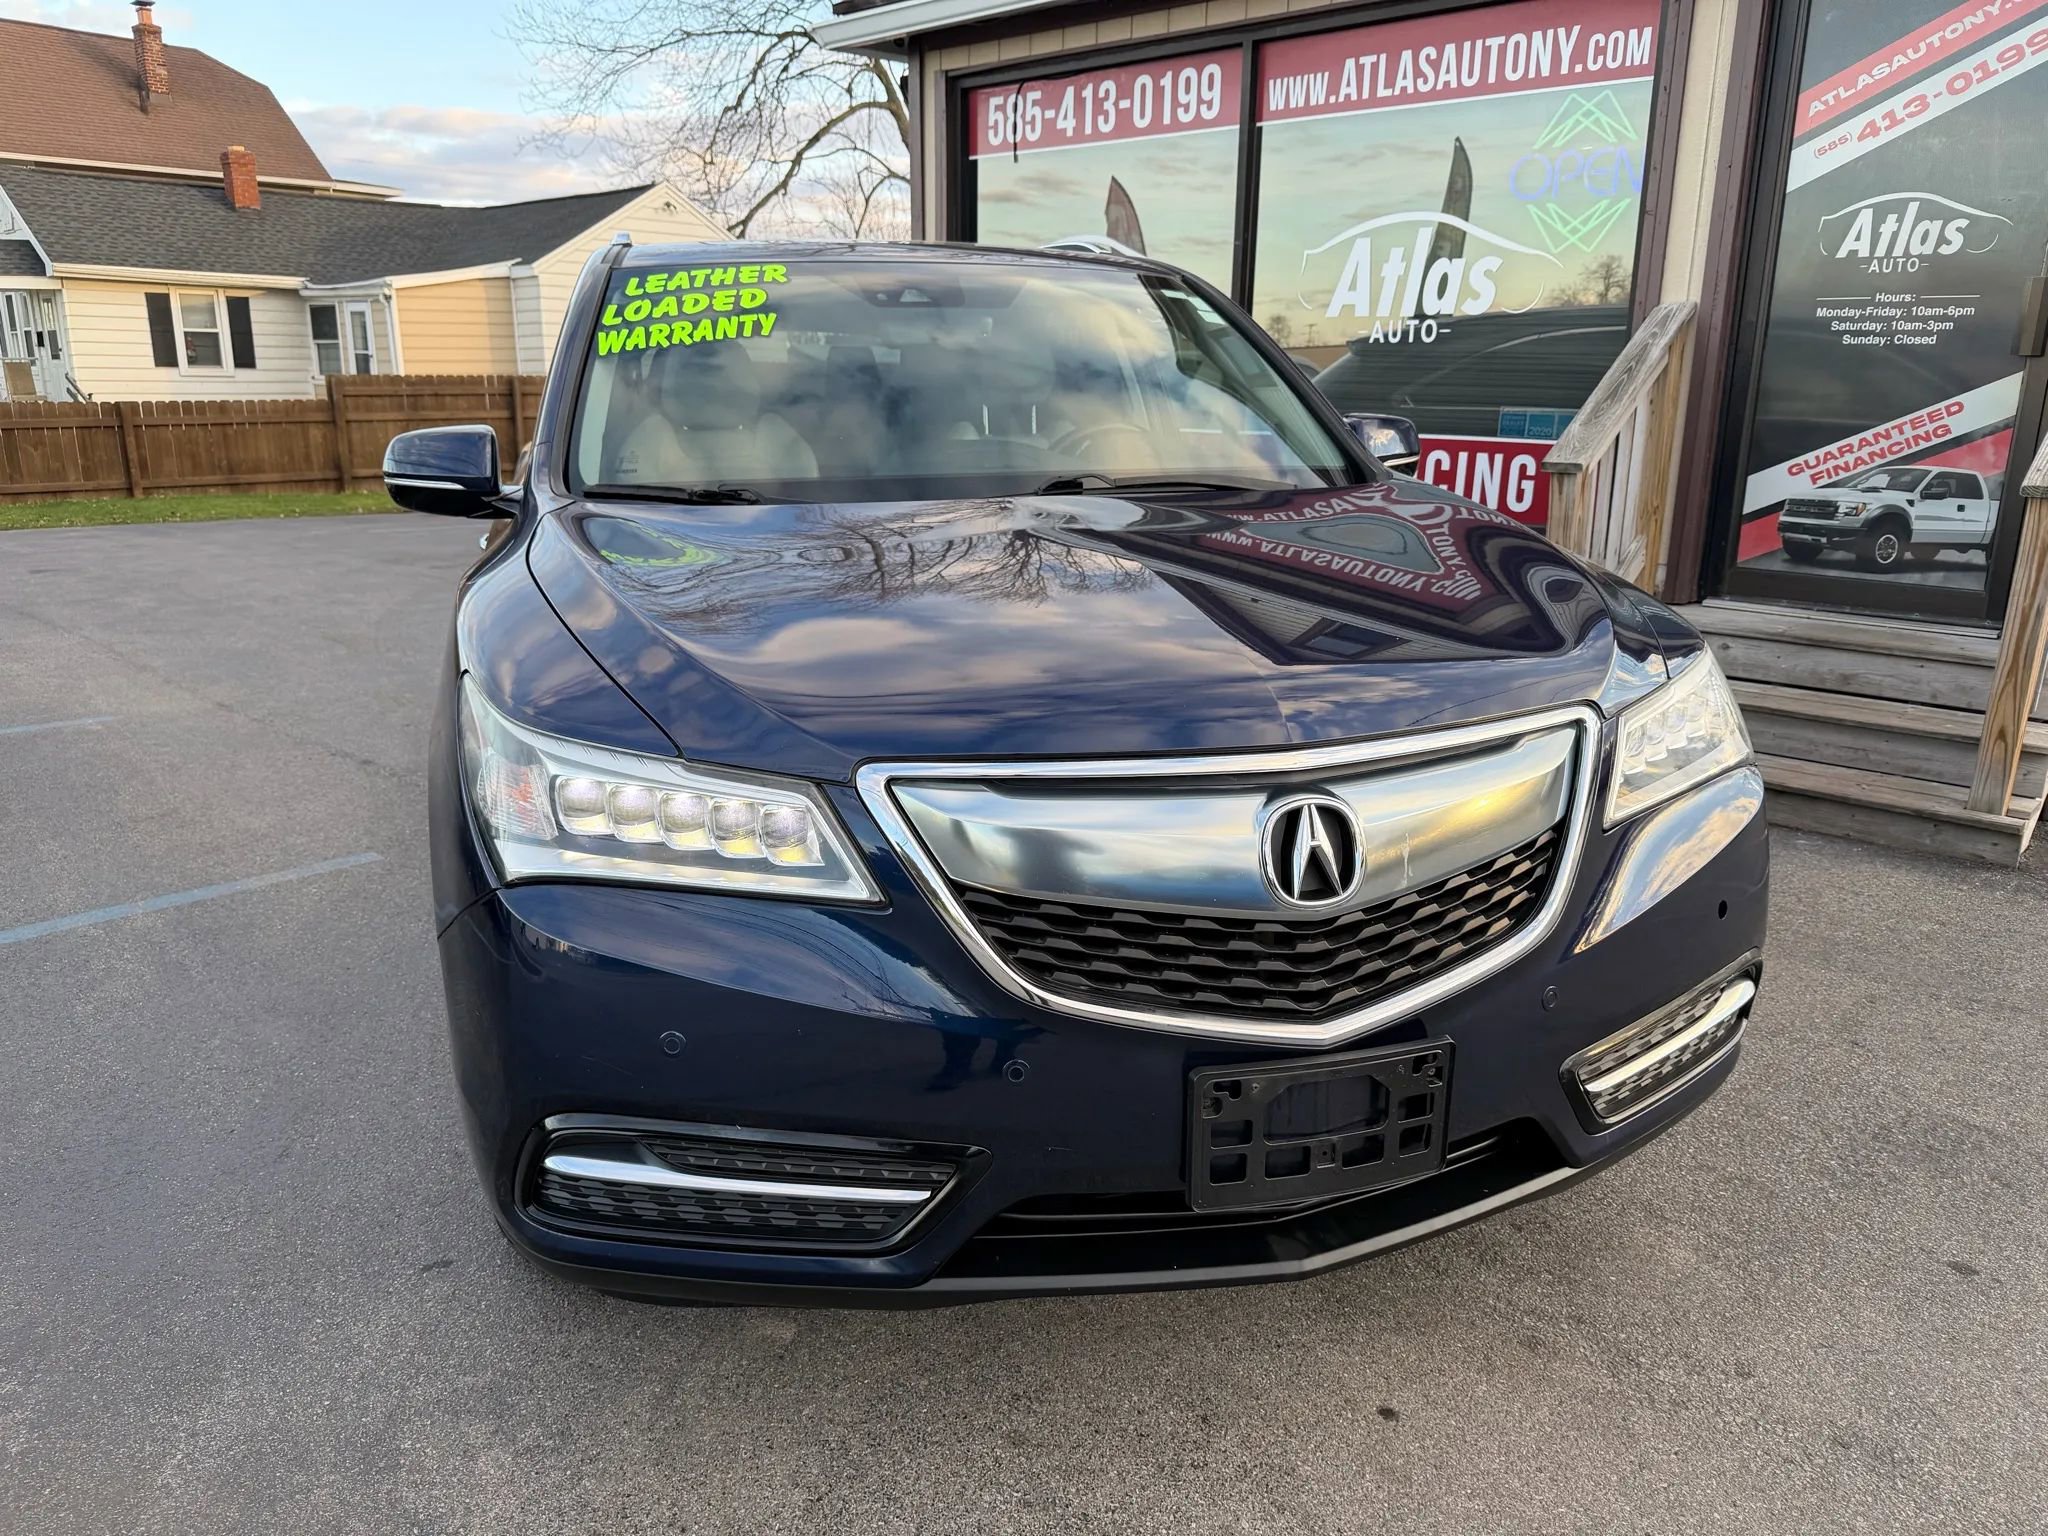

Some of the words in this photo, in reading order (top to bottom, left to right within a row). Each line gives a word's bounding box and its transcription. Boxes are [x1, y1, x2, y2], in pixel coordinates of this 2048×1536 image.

[1268, 25, 1652, 111] WWW.ATLASAUTONY.COM
[1807, 0, 2023, 117] ATLASAUTONY.
[987, 63, 1222, 145] 585-413-0199
[1813, 131, 1852, 159] (585)
[1857, 29, 2048, 143] 413-0199
[1509, 143, 1644, 201] OPEN
[1835, 201, 1970, 259] Atlas
[625, 264, 788, 296] LEATHER
[1325, 227, 1503, 318] Atlas
[1875, 292, 1916, 303] Hours:
[598, 313, 777, 356] WARRANTY
[602, 288, 768, 326] LOADED
[1816, 306, 1907, 319] Monday-Friday:
[1911, 305, 1975, 318] 10am-6pm
[1831, 320, 1887, 332] Saturday:
[1891, 320, 1954, 332] 10am-3pm
[1842, 334, 1891, 346] Sunday:
[1894, 334, 1937, 345] Closed
[1787, 400, 1965, 477] GUARANTEED
[1809, 423, 1952, 486] FINANCING
